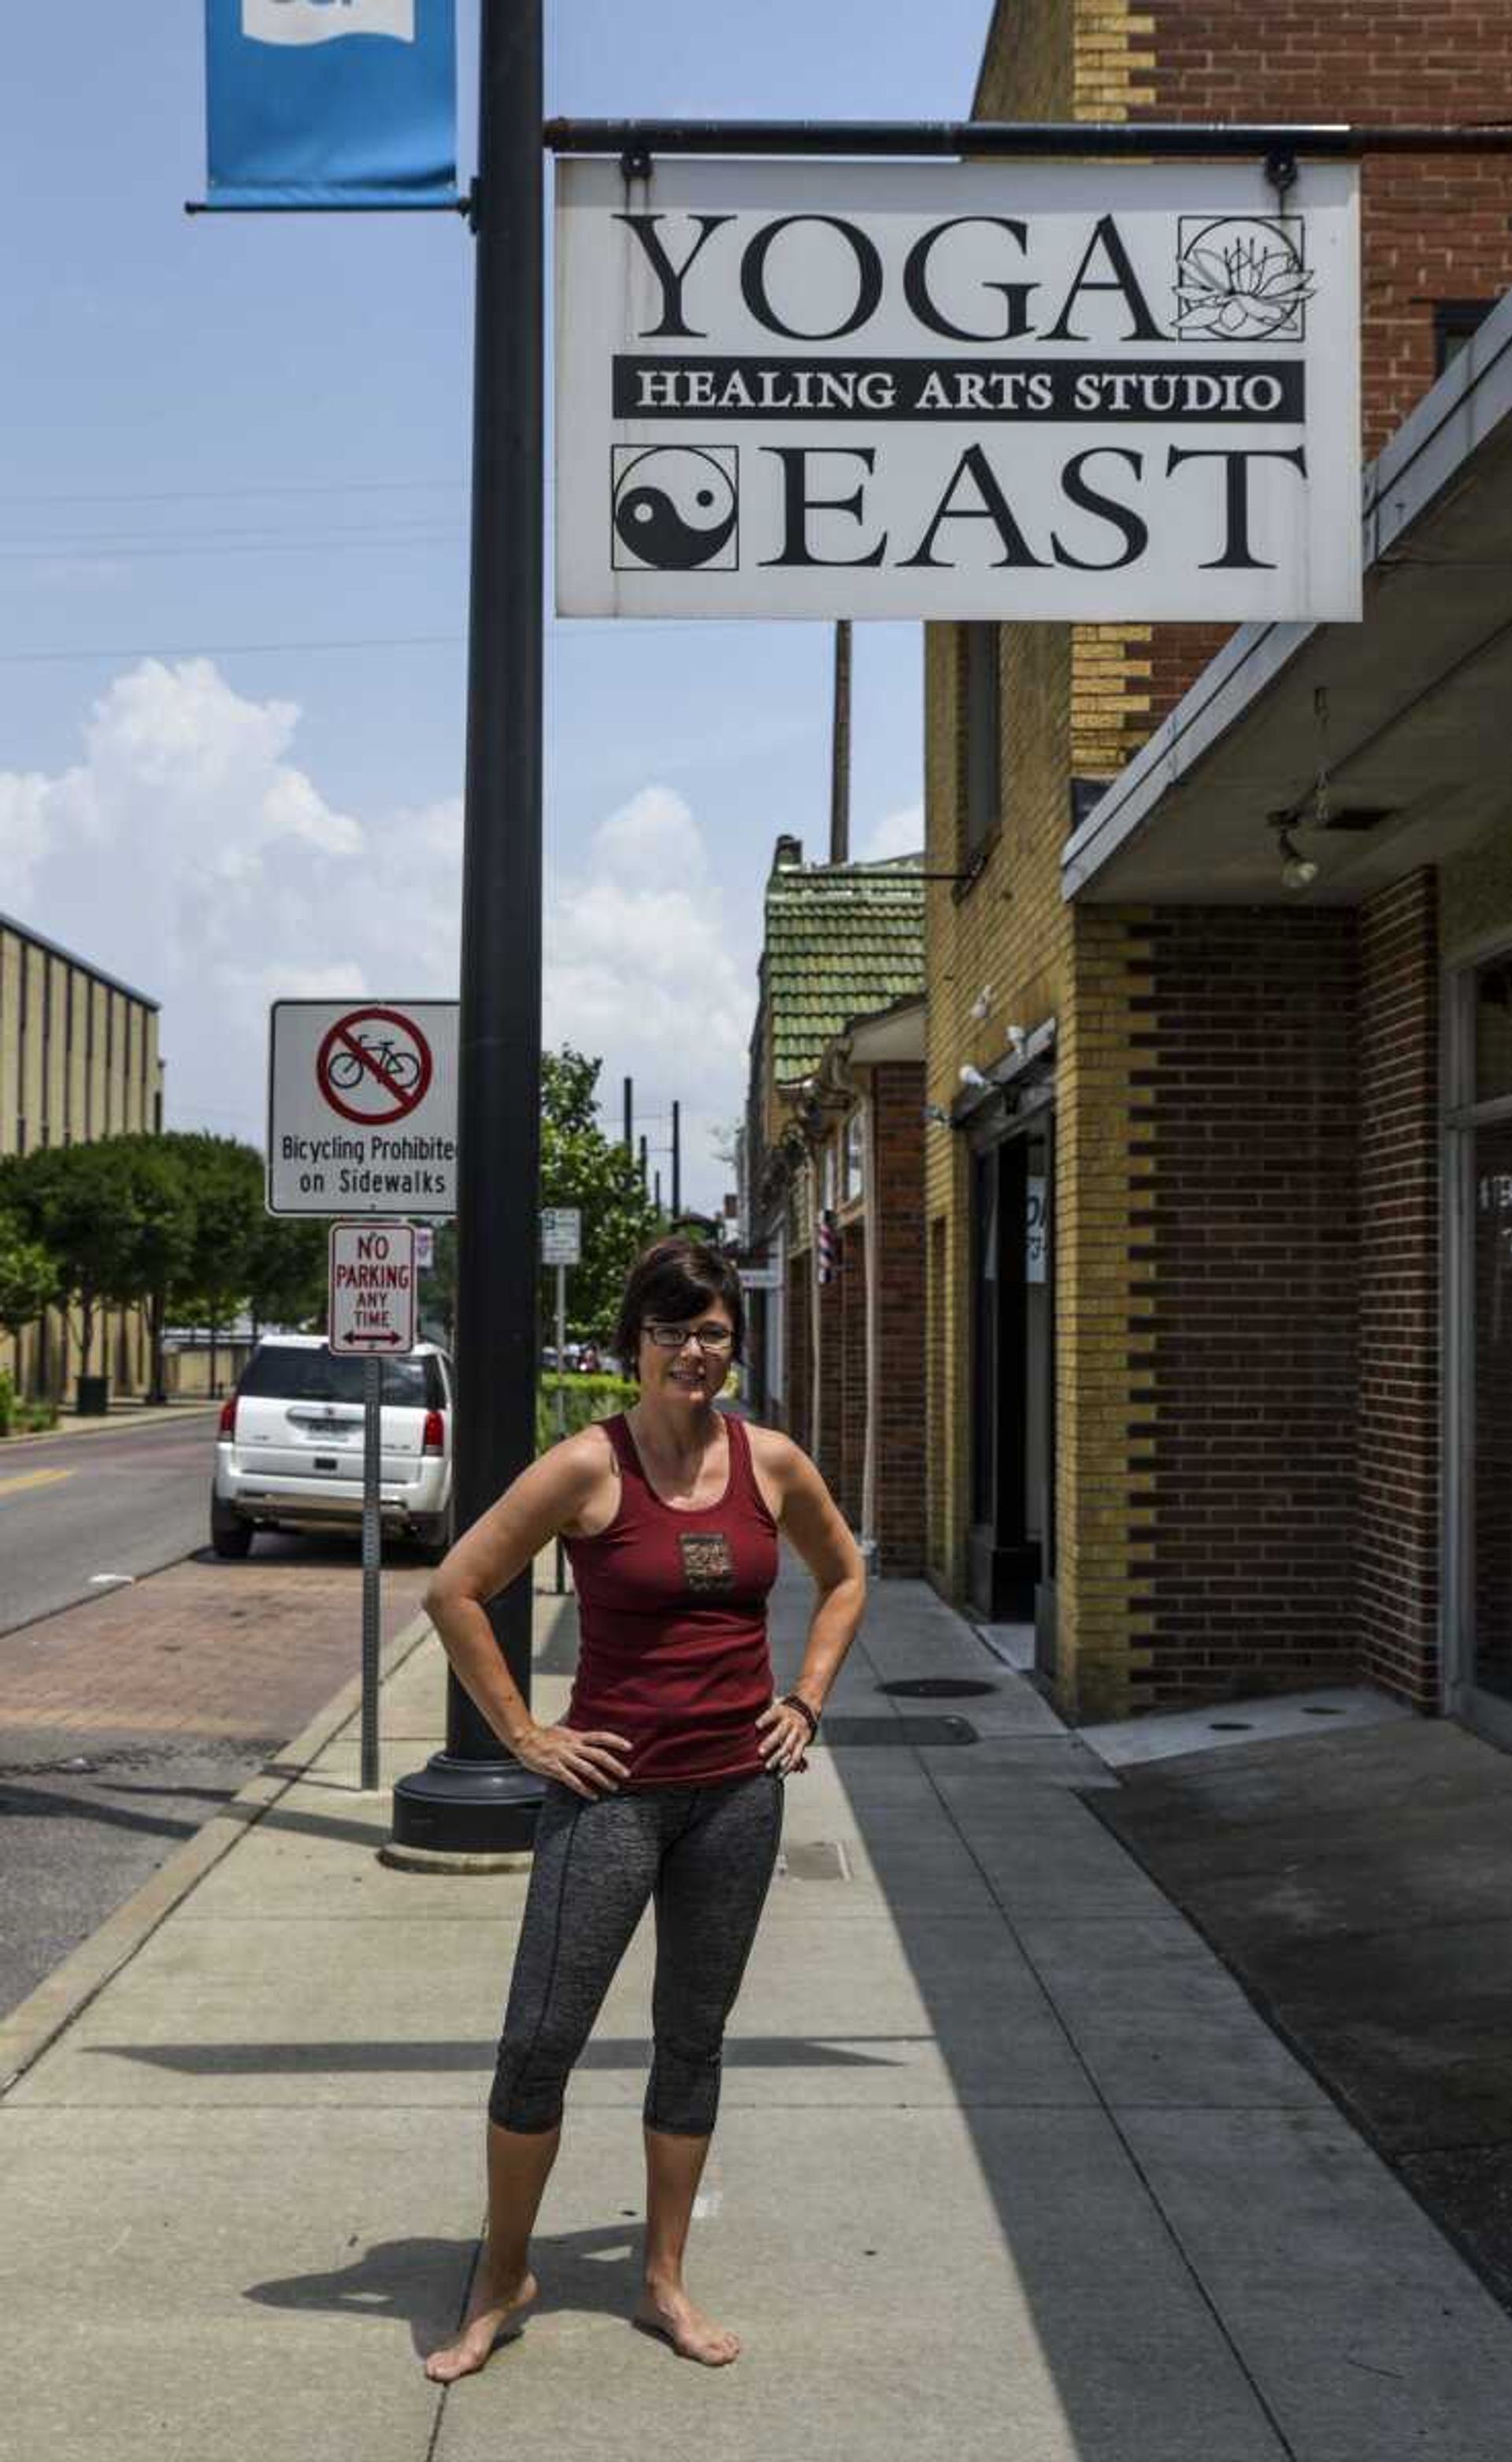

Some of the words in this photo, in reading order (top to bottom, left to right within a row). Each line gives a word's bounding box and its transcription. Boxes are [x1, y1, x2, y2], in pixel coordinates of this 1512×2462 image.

[612, 213, 1175, 342] YOGA
[637, 370, 896, 408] HEALING
[915, 372, 1053, 410] ARTS
[1075, 373, 1282, 410] STUDIO
[757, 443, 1308, 571] EAST
[283, 1136, 365, 1164] Bicycling
[372, 1136, 458, 1161] Prohibite
[300, 1173, 324, 1193] on
[339, 1169, 447, 1194] Sidewalks
[358, 1235, 389, 1260] NO
[336, 1264, 409, 1289] PARKING
[356, 1292, 387, 1308] ANY
[354, 1311, 391, 1328] TIME
